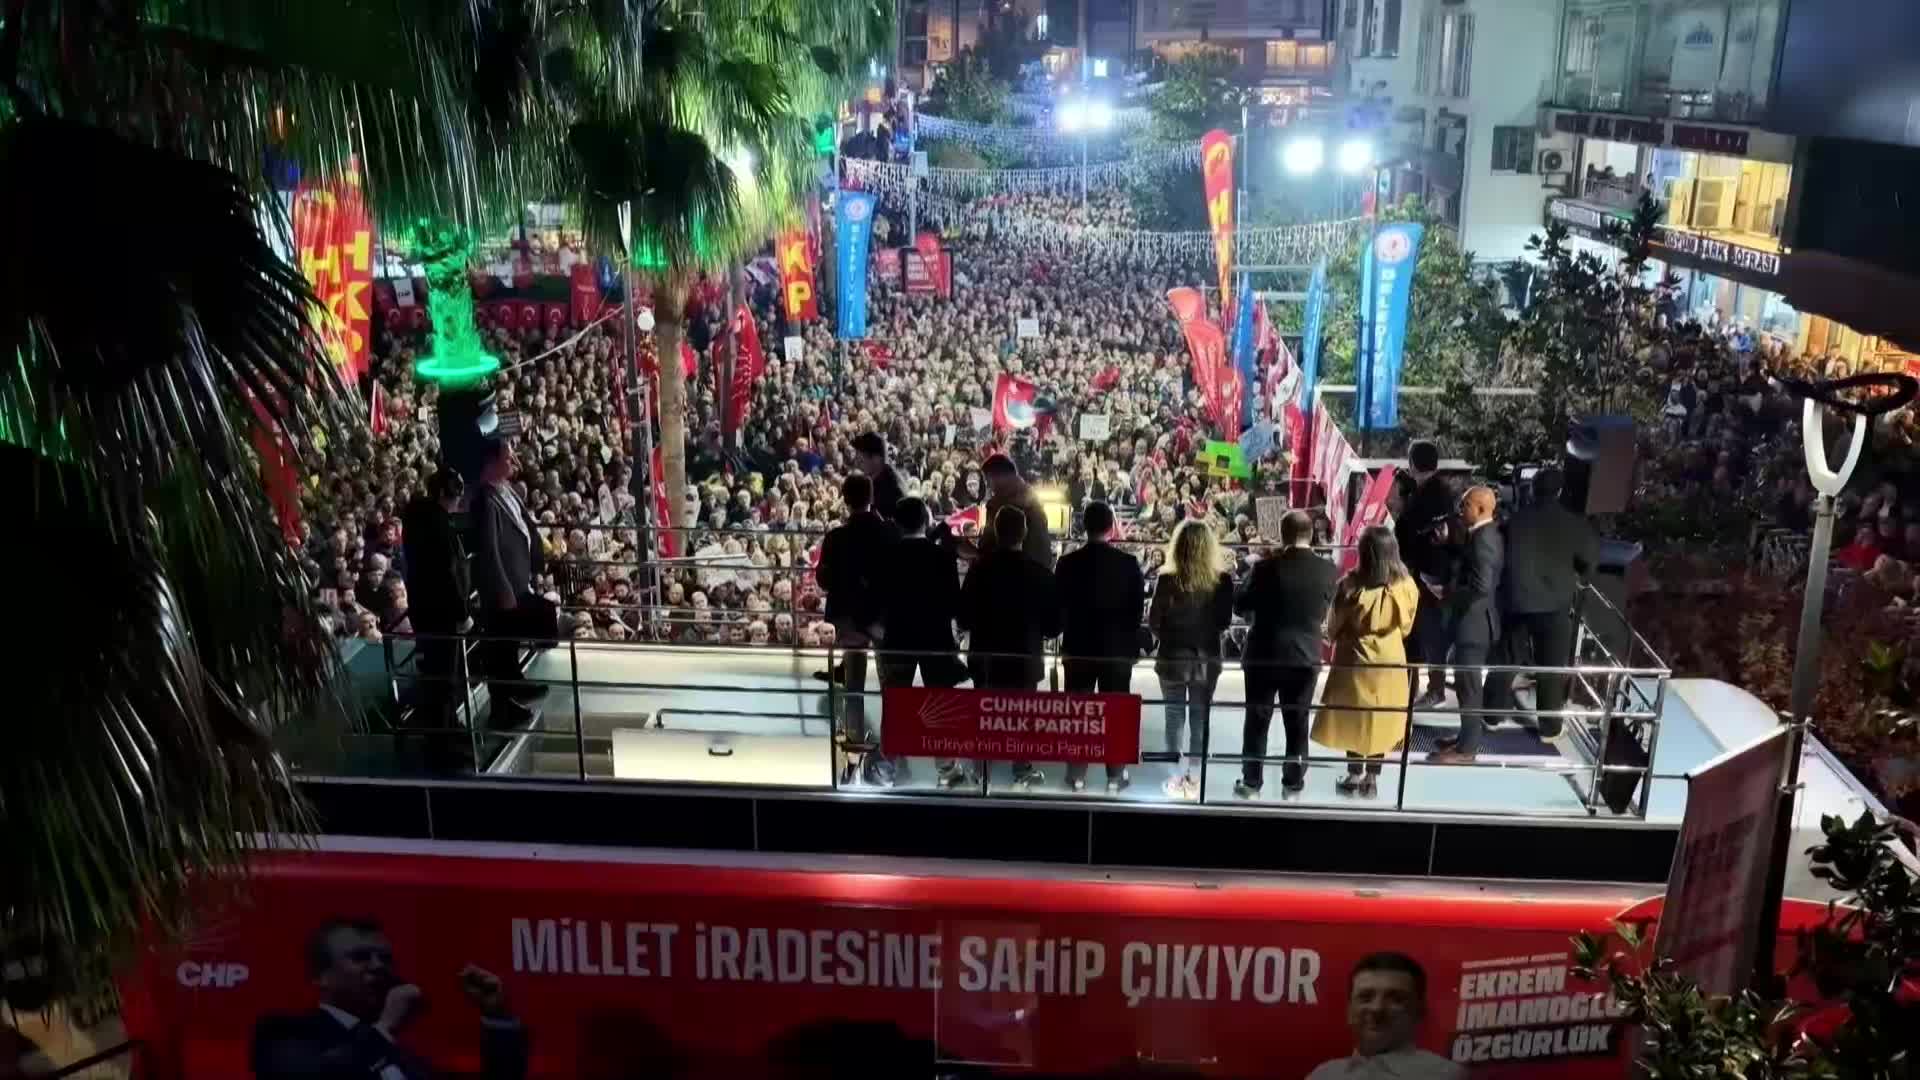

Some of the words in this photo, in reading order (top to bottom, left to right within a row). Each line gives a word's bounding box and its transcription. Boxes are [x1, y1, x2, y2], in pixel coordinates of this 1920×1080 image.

[979, 696, 1106, 717] CUMHURİYET
[980, 716, 1029, 732] HALK
[1034, 716, 1106, 735] PARTİSİ
[1006, 738, 1050, 755] Birinci
[1057, 741, 1105, 758] Partisi
[176, 960, 249, 988] CHP
[511, 917, 679, 978] MİLLET
[694, 920, 943, 990] İRADESİNE
[958, 935, 1105, 996] SAHİP
[1121, 940, 1321, 1007] ÇIKIYOR
[1459, 965, 1567, 1000] EKREM
[1452, 1024, 1613, 1063] ÖZGÜRLÜK
